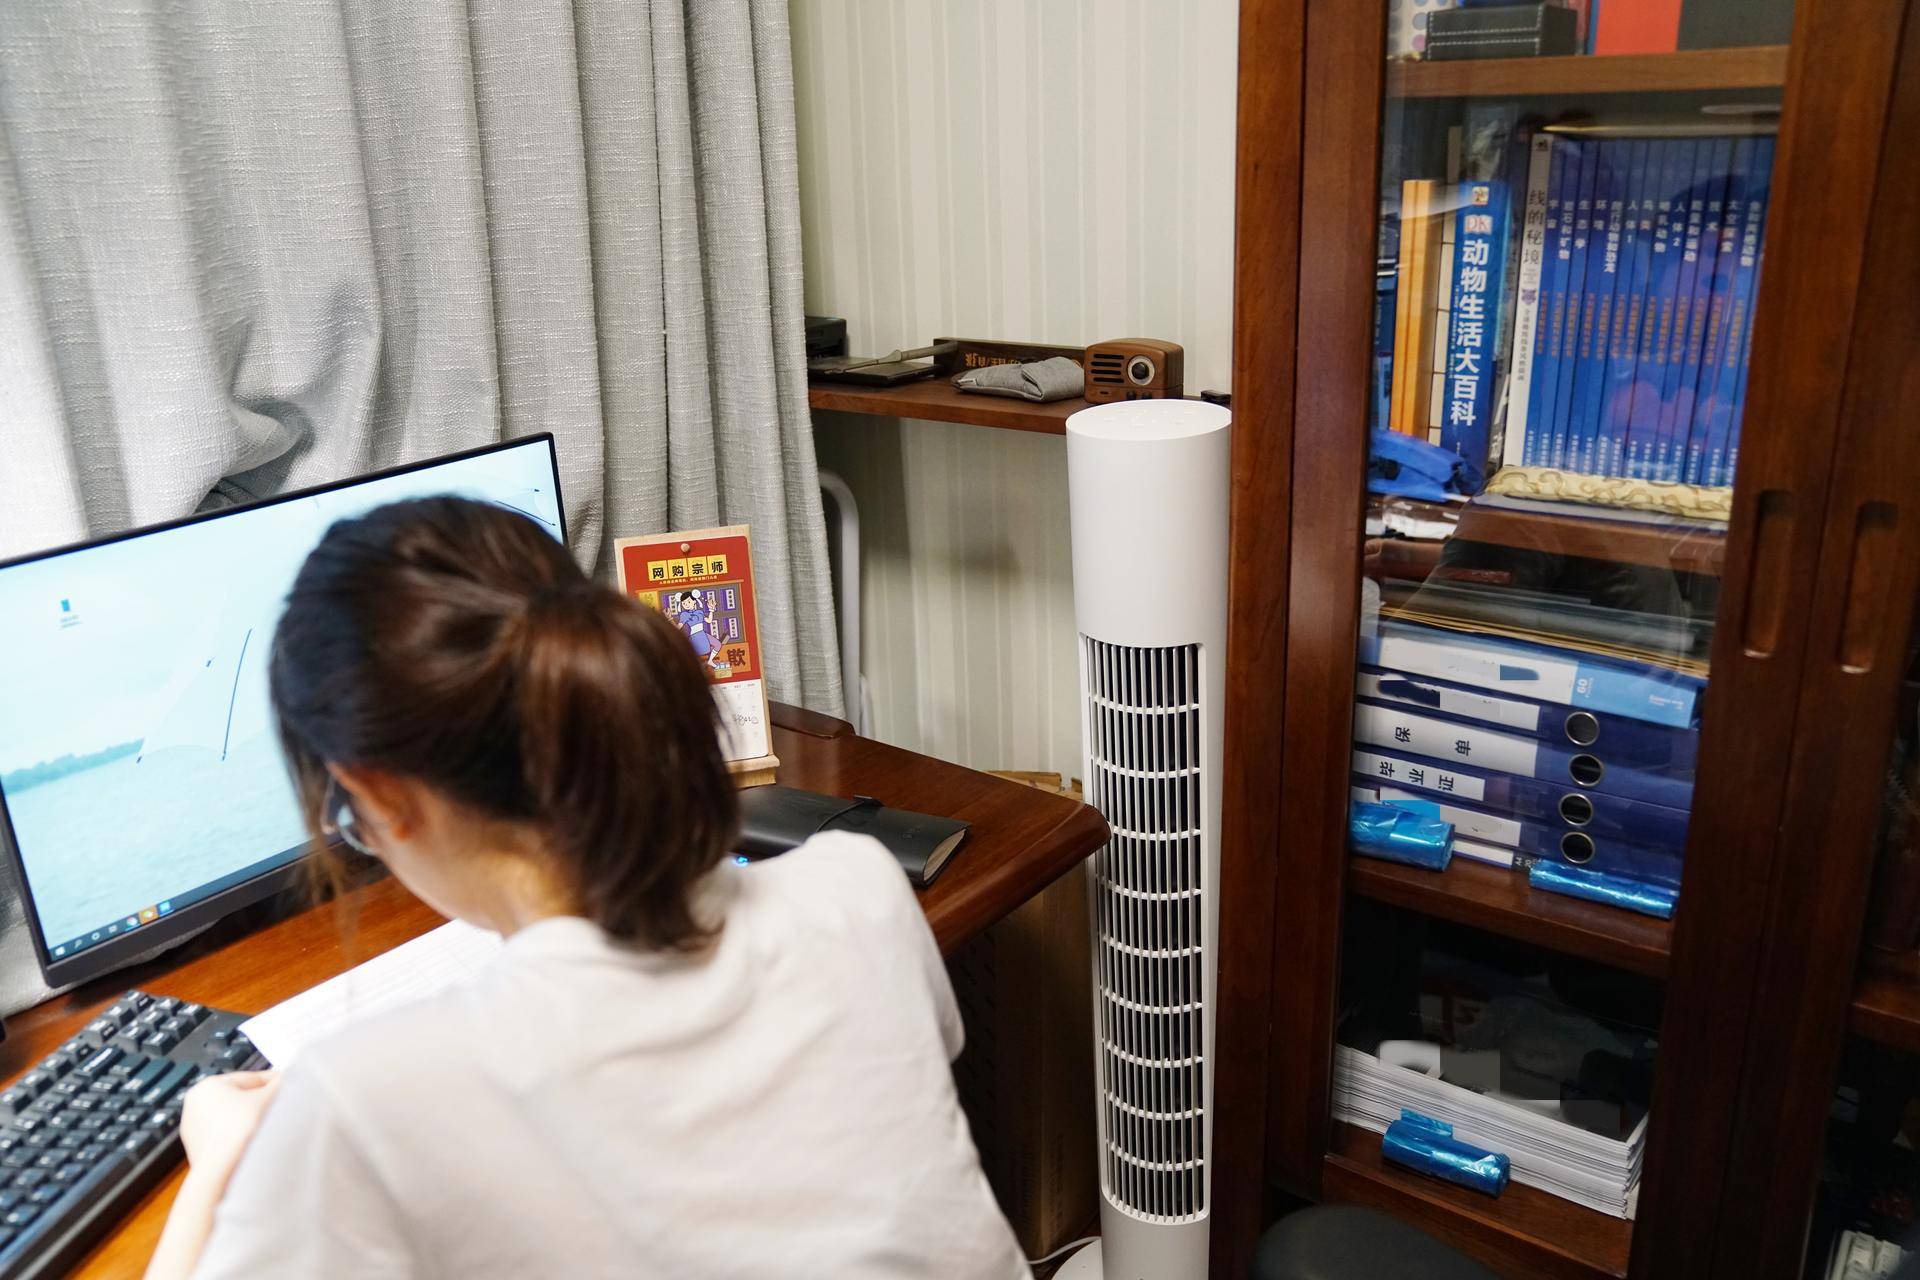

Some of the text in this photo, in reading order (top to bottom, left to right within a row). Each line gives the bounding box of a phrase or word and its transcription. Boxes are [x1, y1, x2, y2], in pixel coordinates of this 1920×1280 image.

[1465, 216, 1491, 232] DK
[1524, 189, 1546, 265] 线的秘境
[1450, 239, 1489, 426] 动物生活大百科
[652, 561, 724, 580] 网购宗师
[1395, 726, 1471, 756] 保单
[1379, 761, 1454, 792] 毕业证
